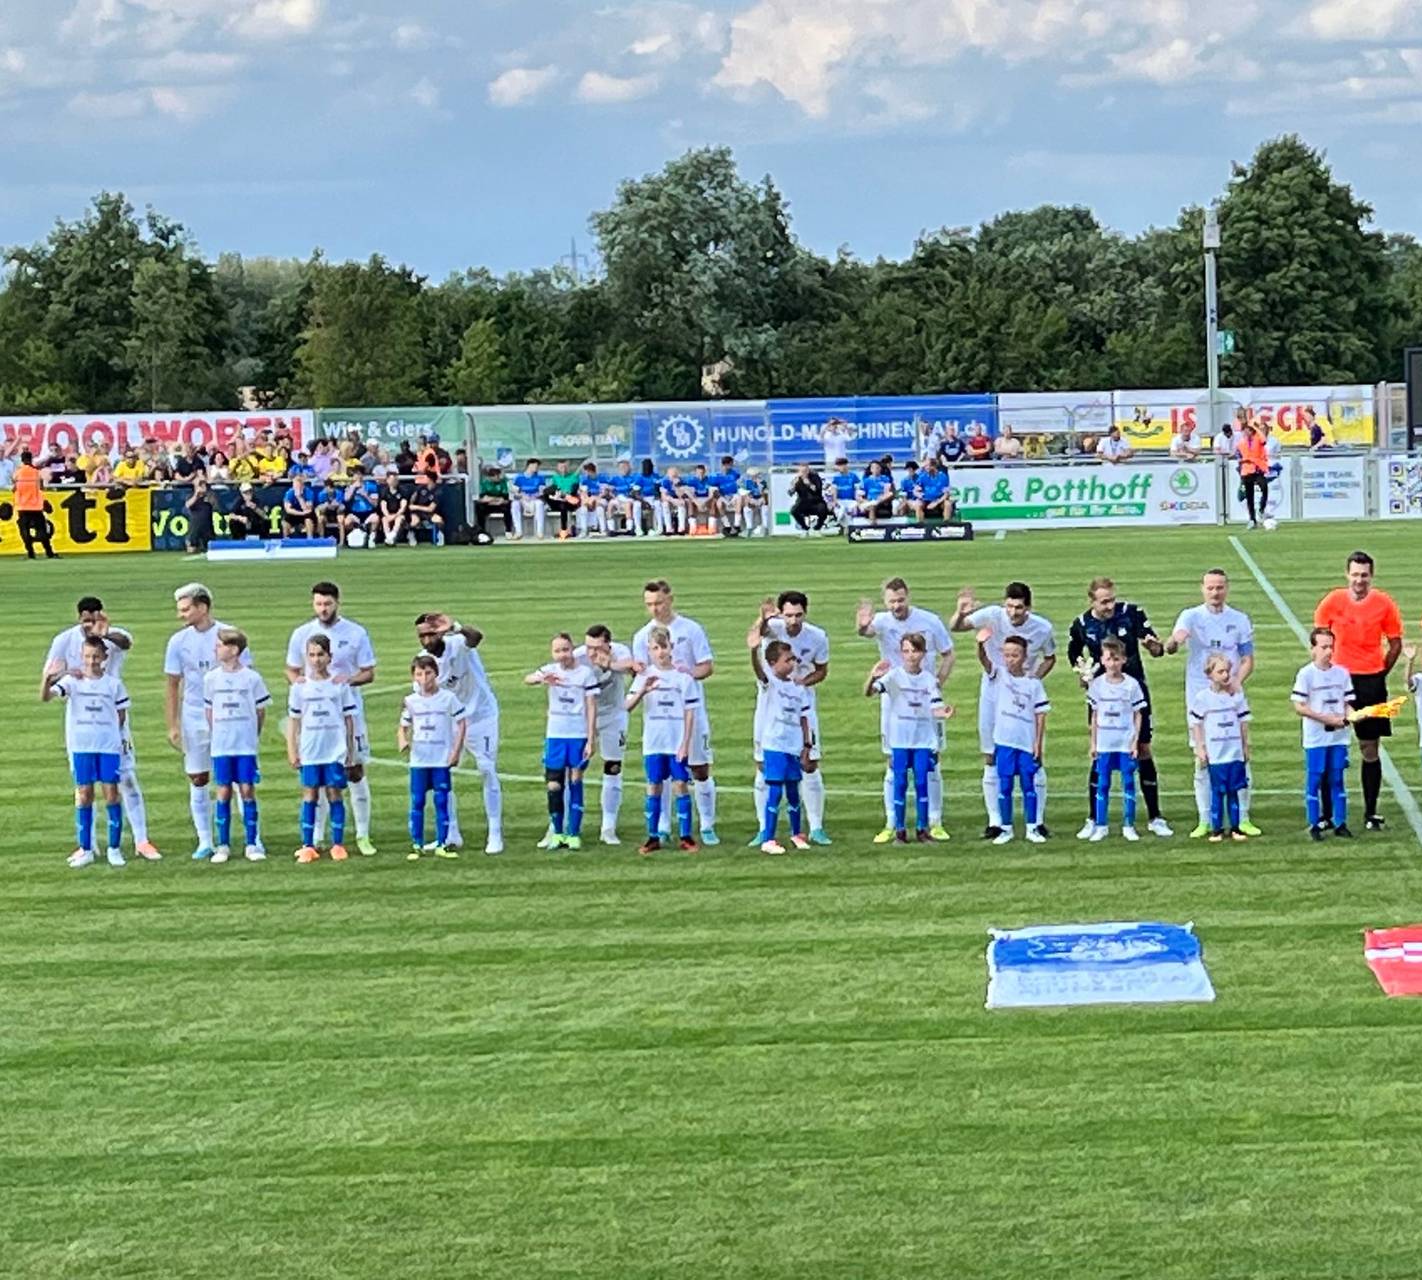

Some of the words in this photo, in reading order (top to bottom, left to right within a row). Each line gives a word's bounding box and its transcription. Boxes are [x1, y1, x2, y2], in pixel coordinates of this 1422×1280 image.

[367, 421, 382, 437] &
[991, 477, 1012, 503] &
[1025, 472, 1153, 502] Potthoff
